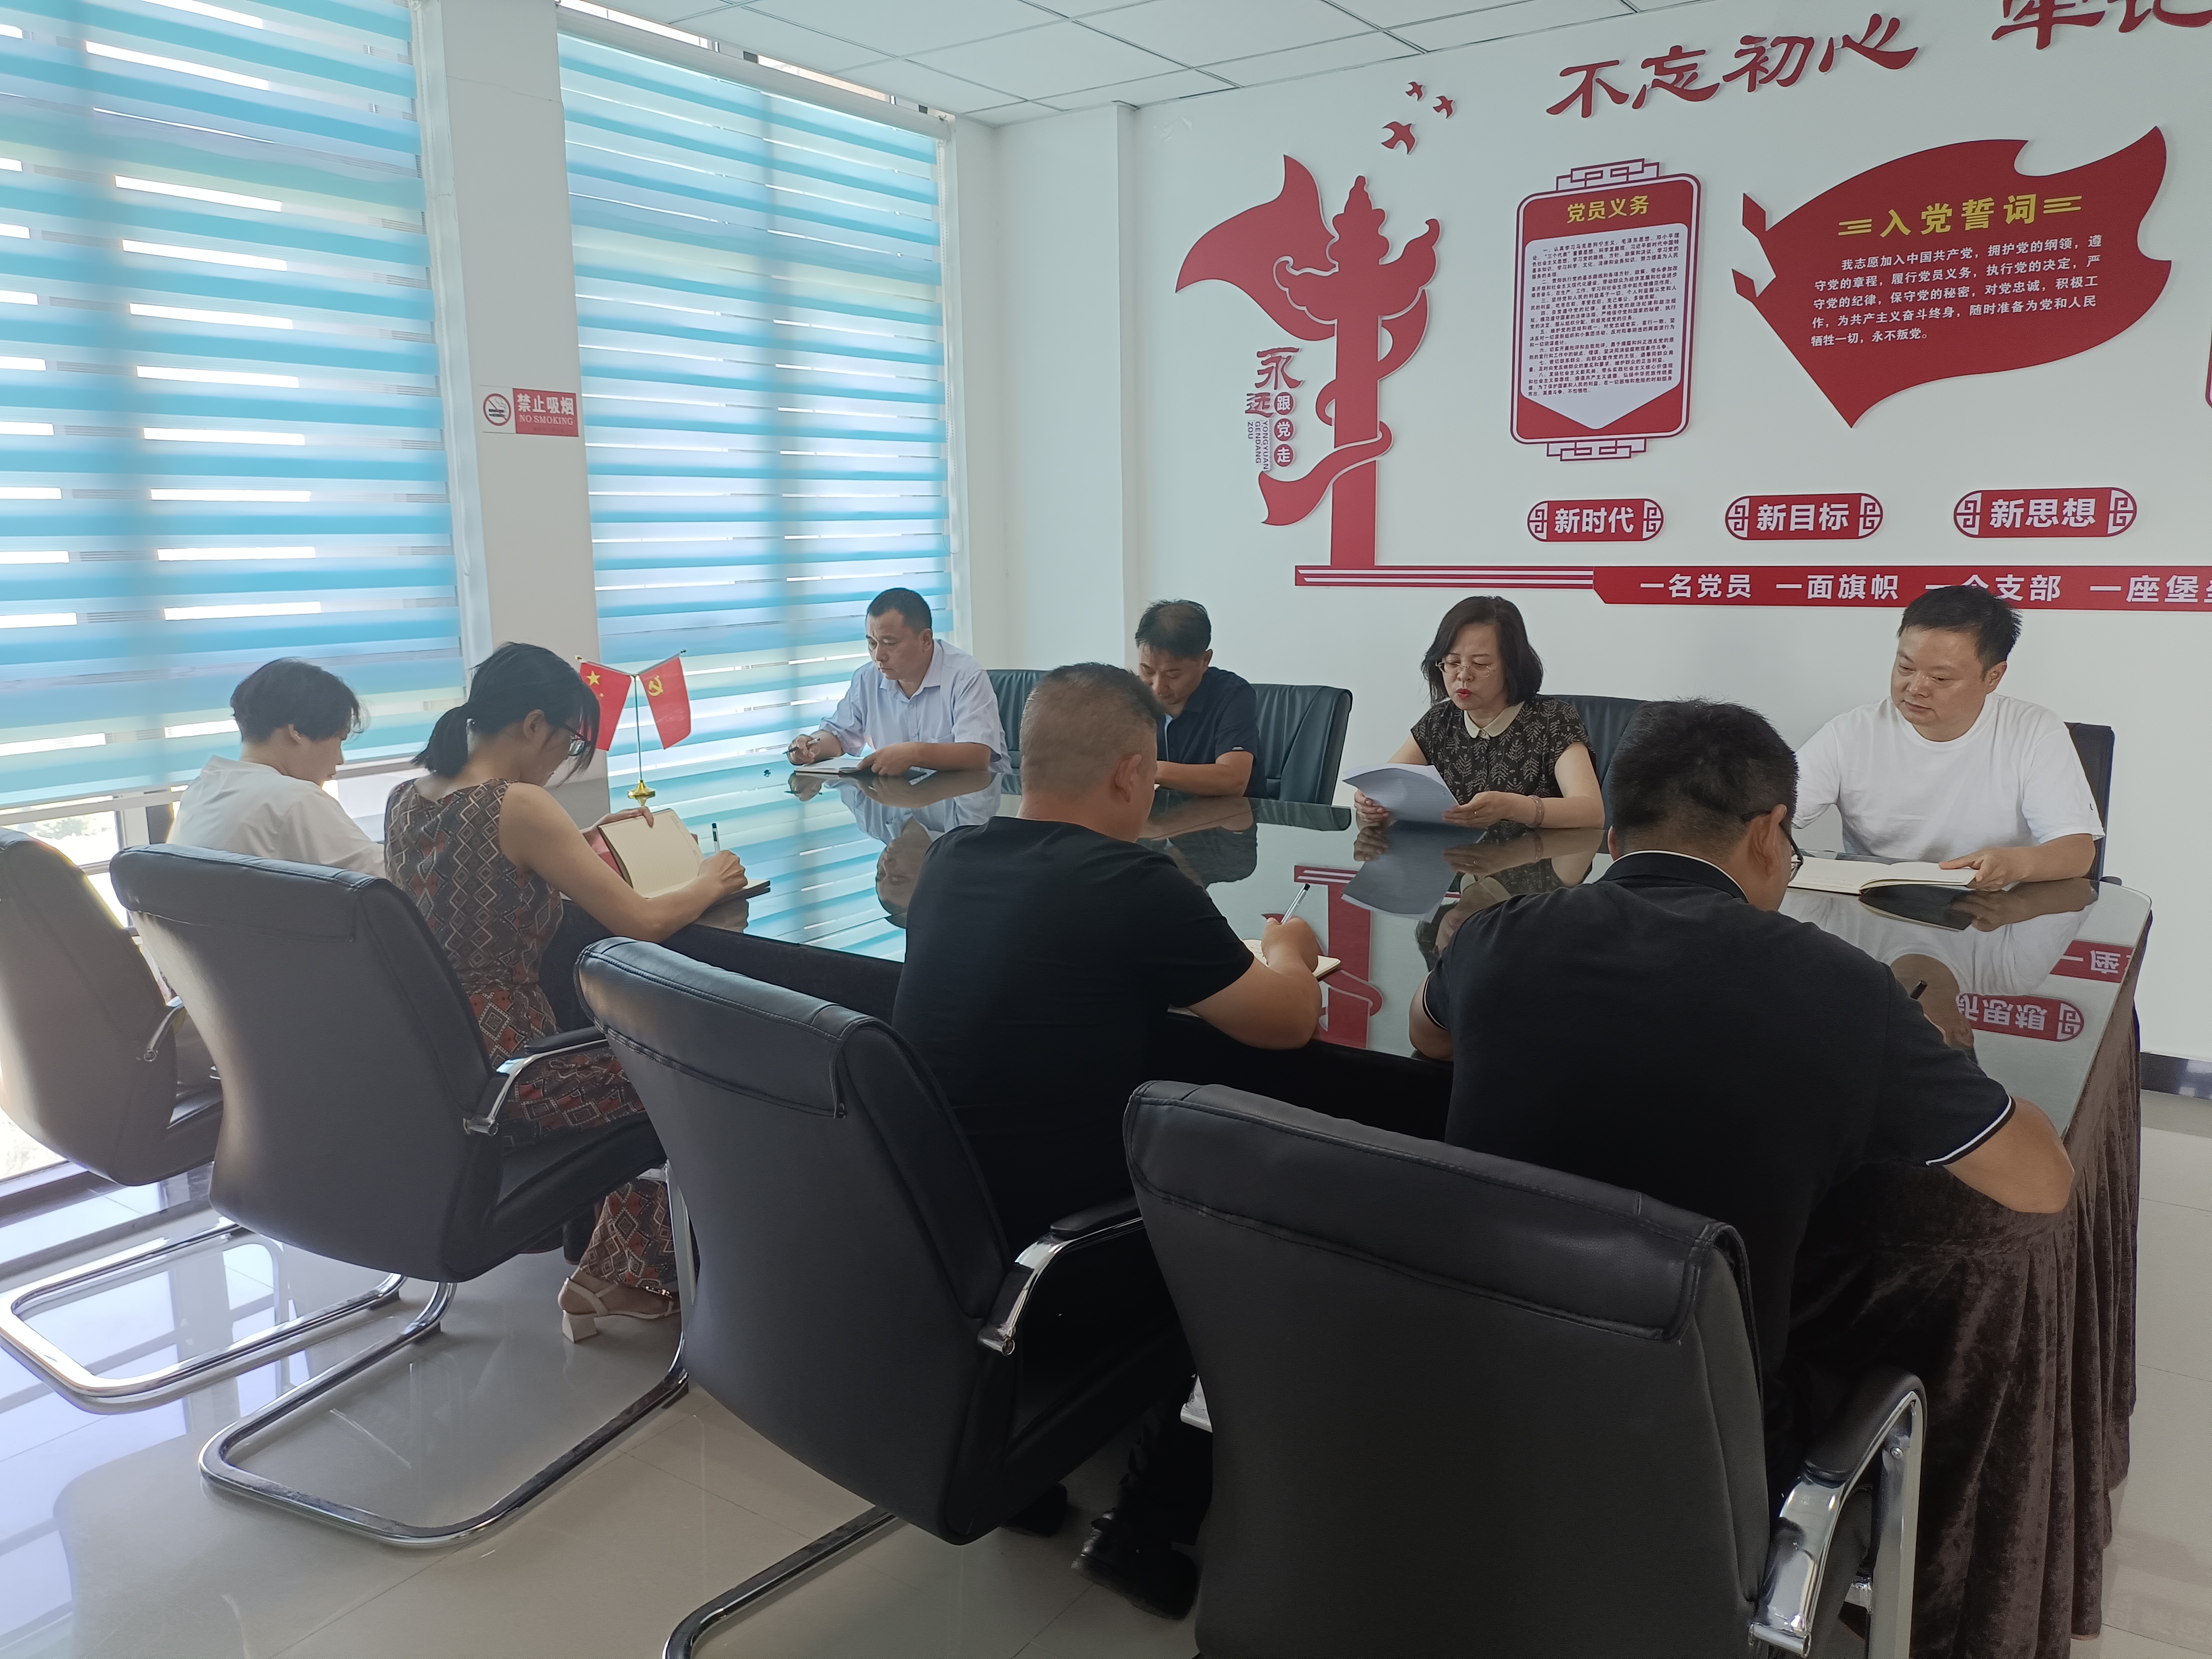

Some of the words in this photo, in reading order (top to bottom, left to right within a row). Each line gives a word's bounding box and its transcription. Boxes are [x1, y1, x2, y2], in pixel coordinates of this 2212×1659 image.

[1546, 13, 1919, 118] 不忘初心
[1567, 195, 1649, 224] 党员义务
[1879, 193, 2037, 238] 入党誓词
[1841, 234, 2103, 271] 我志愿加入中国共产党，拥护党的纲领，遵
[1814, 254, 2101, 292] 守党的章程，履行党员义务，执行党的决定，严
[1813, 276, 2098, 310] 守党的纪律，保守党的秘密，对党忠诚，积极工
[1812, 295, 2096, 329] 作，为共产主义奋斗终身，随时准备为党和人民
[1811, 327, 1927, 347] 牺牲一切，永不叛党。
[1245, 347, 1303, 418] 永远
[517, 393, 575, 416] 禁止吸烟
[519, 414, 532, 422] NO
[533, 415, 574, 425] SMOKING
[1276, 395, 1292, 464] 跟党走
[1554, 506, 1635, 534] 新时代
[1755, 503, 1849, 531] 新目标
[1989, 498, 2096, 529] 新思想
[1640, 573, 1752, 599] 一名党员
[1776, 573, 1899, 600] 一面旗帜
[2090, 574, 2212, 603] 一座堡
